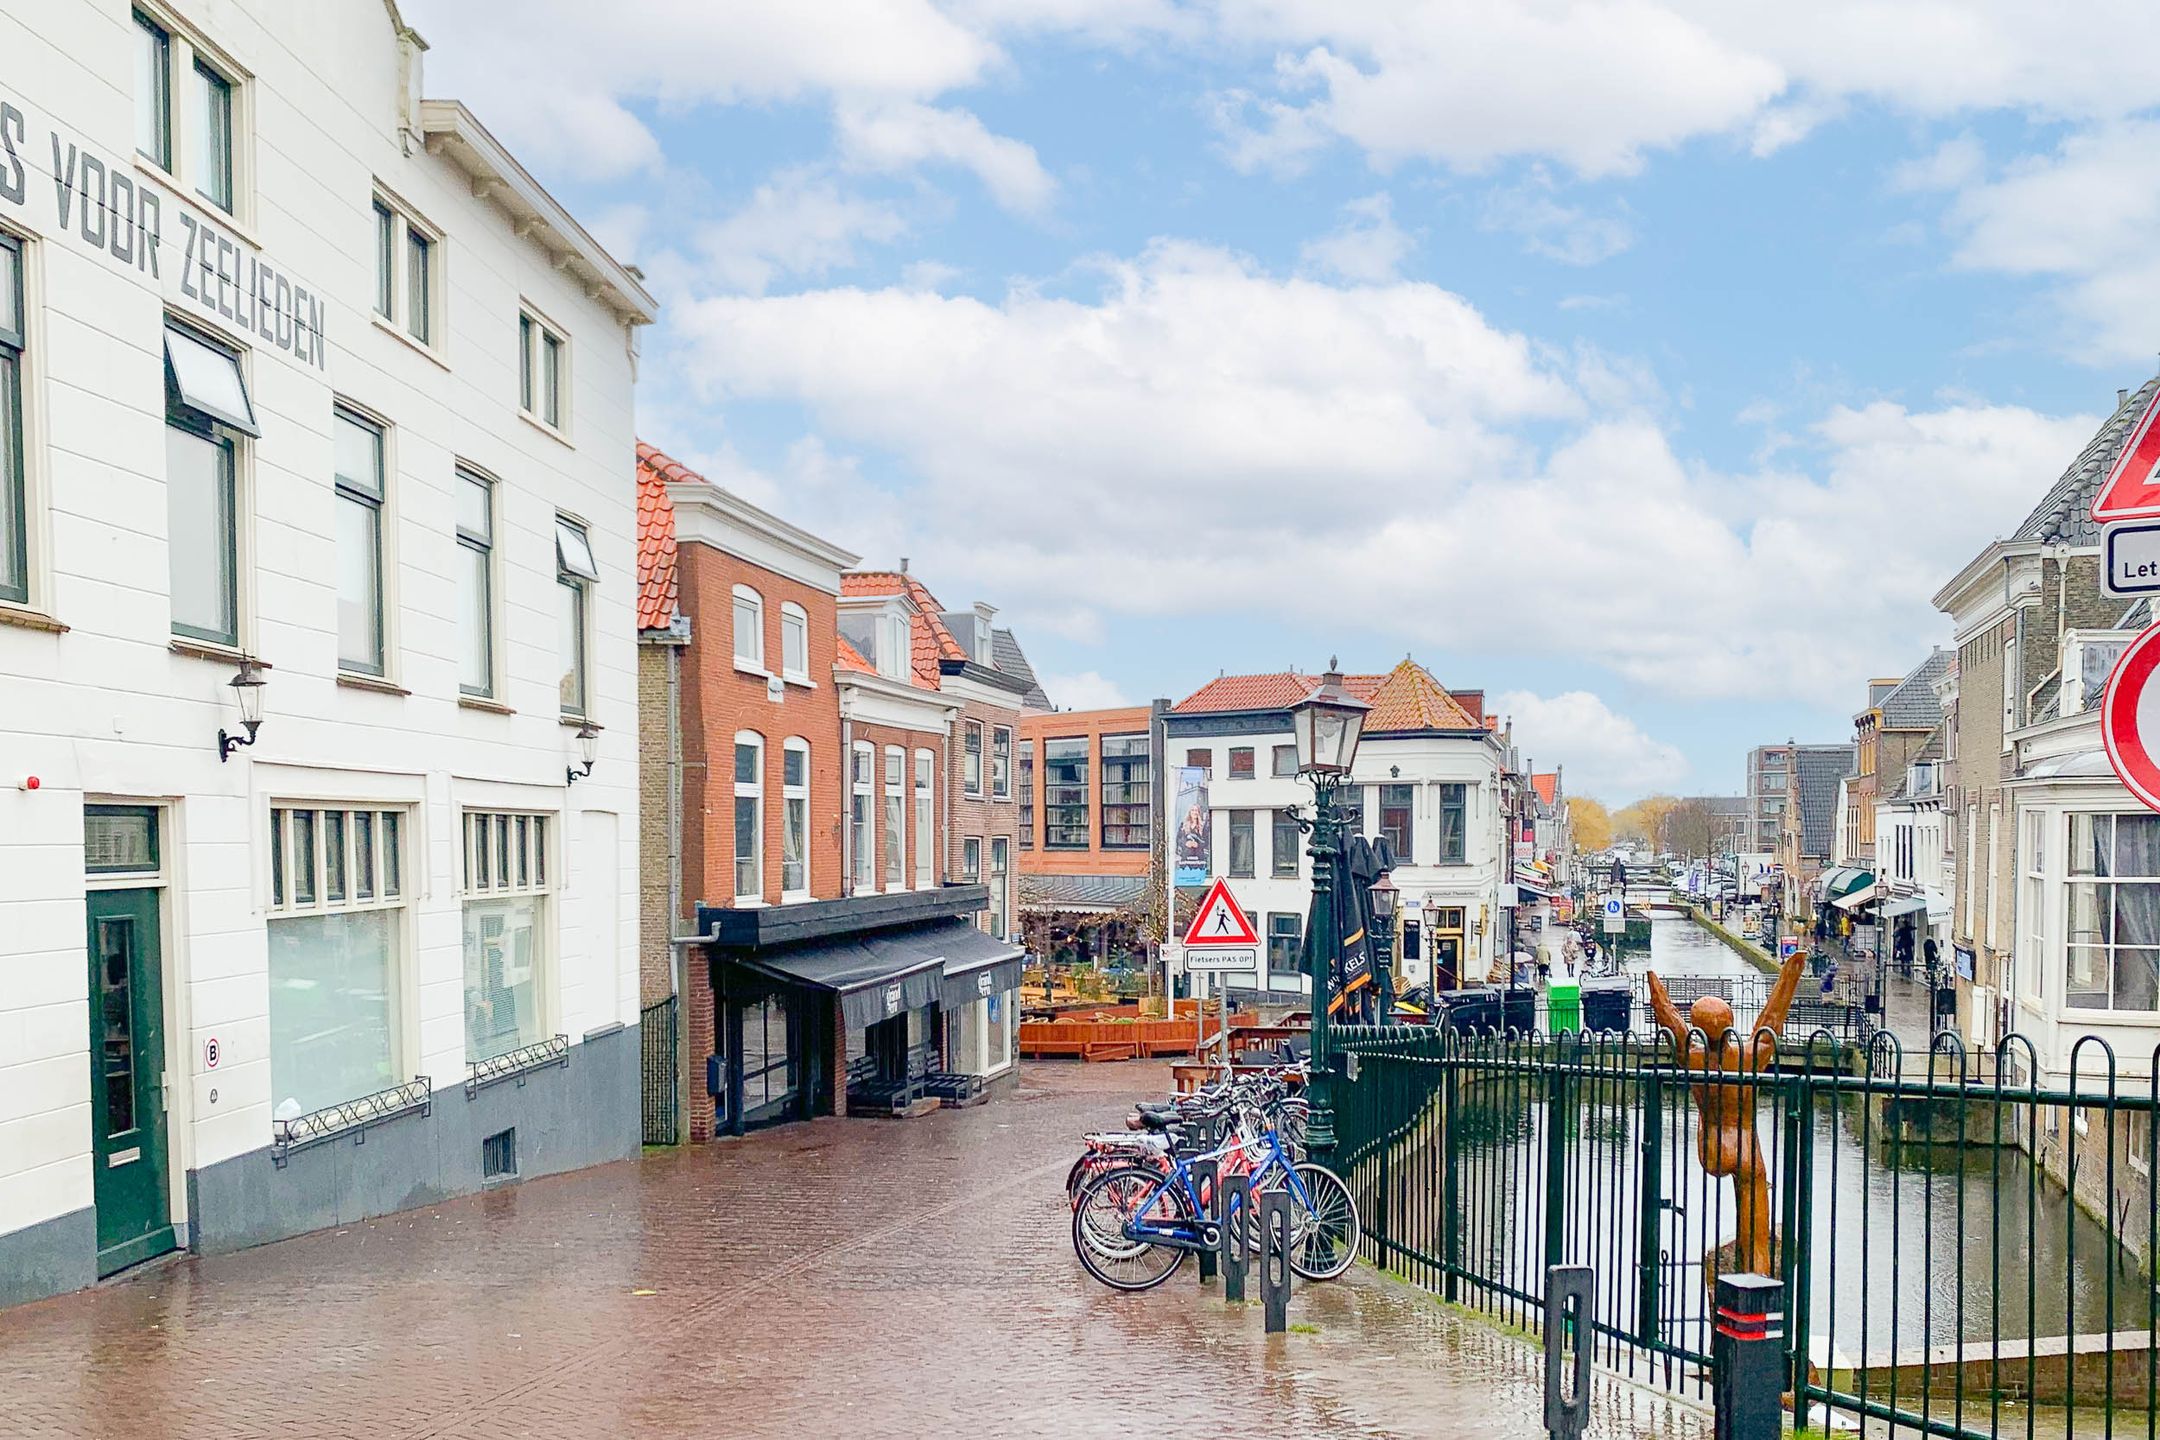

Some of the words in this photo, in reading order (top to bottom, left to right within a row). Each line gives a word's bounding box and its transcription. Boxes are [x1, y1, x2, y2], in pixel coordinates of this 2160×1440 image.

[50, 131, 160, 280] VOOR
[179, 211, 325, 372] ZEELIEDEN
[2125, 561, 2158, 578] Let
[210, 1045, 216, 1061] B
